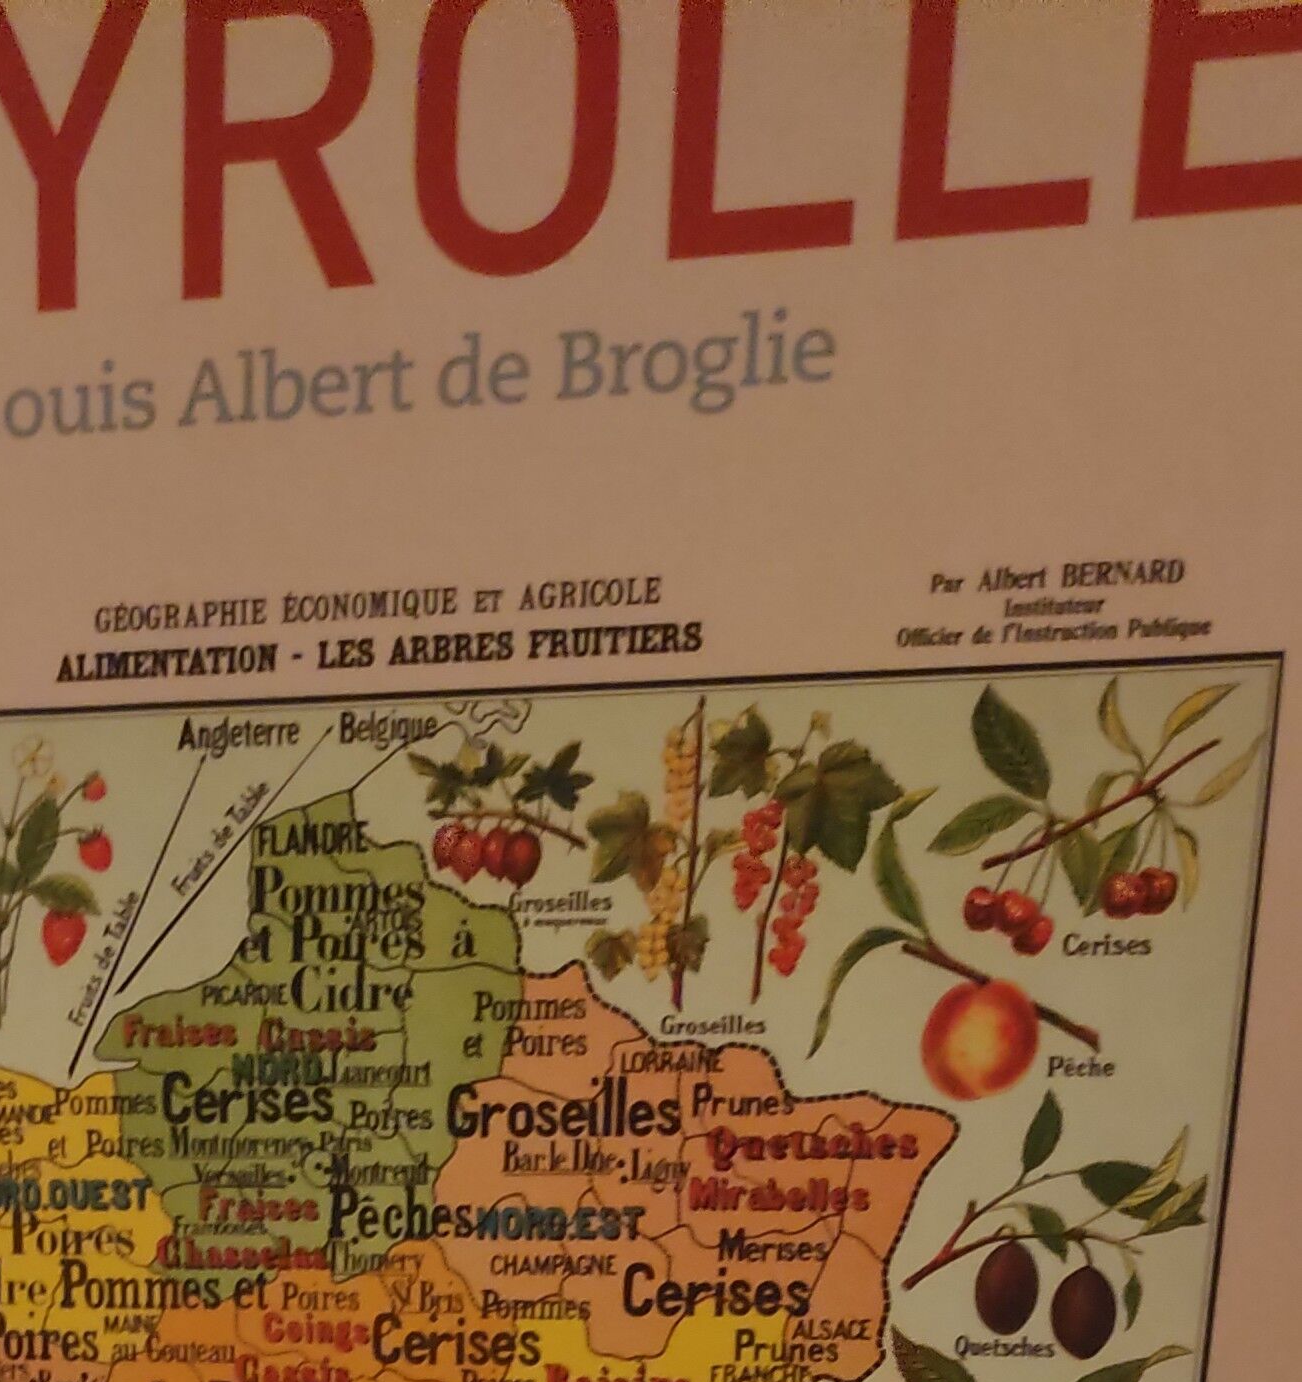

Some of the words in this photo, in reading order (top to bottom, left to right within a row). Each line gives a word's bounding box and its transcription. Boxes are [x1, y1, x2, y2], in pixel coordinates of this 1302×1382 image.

[180, 337, 415, 430] Albert
[436, 331, 531, 408] de
[556, 311, 838, 414] Broglie
[930, 573, 965, 595] Par
[977, 566, 1046, 592] Albert
[1061, 560, 1185, 589] BERNARD
[95, 599, 266, 633] GÉOGRAPHIE
[282, 586, 458, 625] ÉCONOMIQUE
[473, 590, 503, 613] ET
[519, 577, 663, 611] AGRICOLE
[1004, 596, 1105, 618] Instituteur
[897, 624, 963, 648] Officier
[972, 625, 992, 645] de
[1001, 620, 1119, 644] l'Instruction
[1128, 617, 1212, 642] Publique
[56, 643, 278, 683] ALIMENTATION
[317, 640, 375, 670] LES
[388, 631, 515, 665] ARBRES
[527, 622, 702, 659] FRUITIERS
[177, 718, 300, 758] Angleterre
[340, 712, 439, 751] Belgique
[257, 822, 368, 857] FLANDRE
[252, 865, 427, 914] Pommes
[508, 891, 613, 913] Groseilles
[240, 927, 270, 965] et
[291, 909, 427, 962] Poires
[1063, 933, 1153, 956] Cerises
[201, 984, 288, 1007] PICARDIE
[291, 966, 415, 1014] Cidre
[474, 991, 589, 1022] Pommes
[122, 1012, 239, 1050] Fraises
[660, 1013, 767, 1036] Groseilles
[502, 1027, 589, 1058] Poires
[620, 1051, 724, 1075] LORRAINE
[1048, 1056, 1116, 1078] Pêche
[54, 1087, 158, 1117] Pommes
[162, 1070, 335, 1125] Cerises
[445, 1077, 683, 1140] Groseilles
[690, 1083, 797, 1120] Prunes
[349, 1099, 434, 1132] Poires
[86, 1129, 165, 1159] Poires
[706, 1125, 919, 1172] Quetsches
[688, 1176, 872, 1214] Mirabelles
[329, 1185, 476, 1242] Pêches
[12, 1210, 136, 1258] Poires
[717, 1228, 831, 1264] Merises
[489, 1253, 618, 1278] CHAMPAGNE
[60, 1258, 223, 1310] Pommes
[233, 1272, 270, 1311] et
[281, 1280, 361, 1311] Poires
[621, 1262, 811, 1320] Cerises
[480, 1289, 592, 1322] Pommes
[372, 1311, 543, 1368] Cerises
[734, 1328, 839, 1363] Prunes
[954, 1335, 1056, 1360] Quetsches
